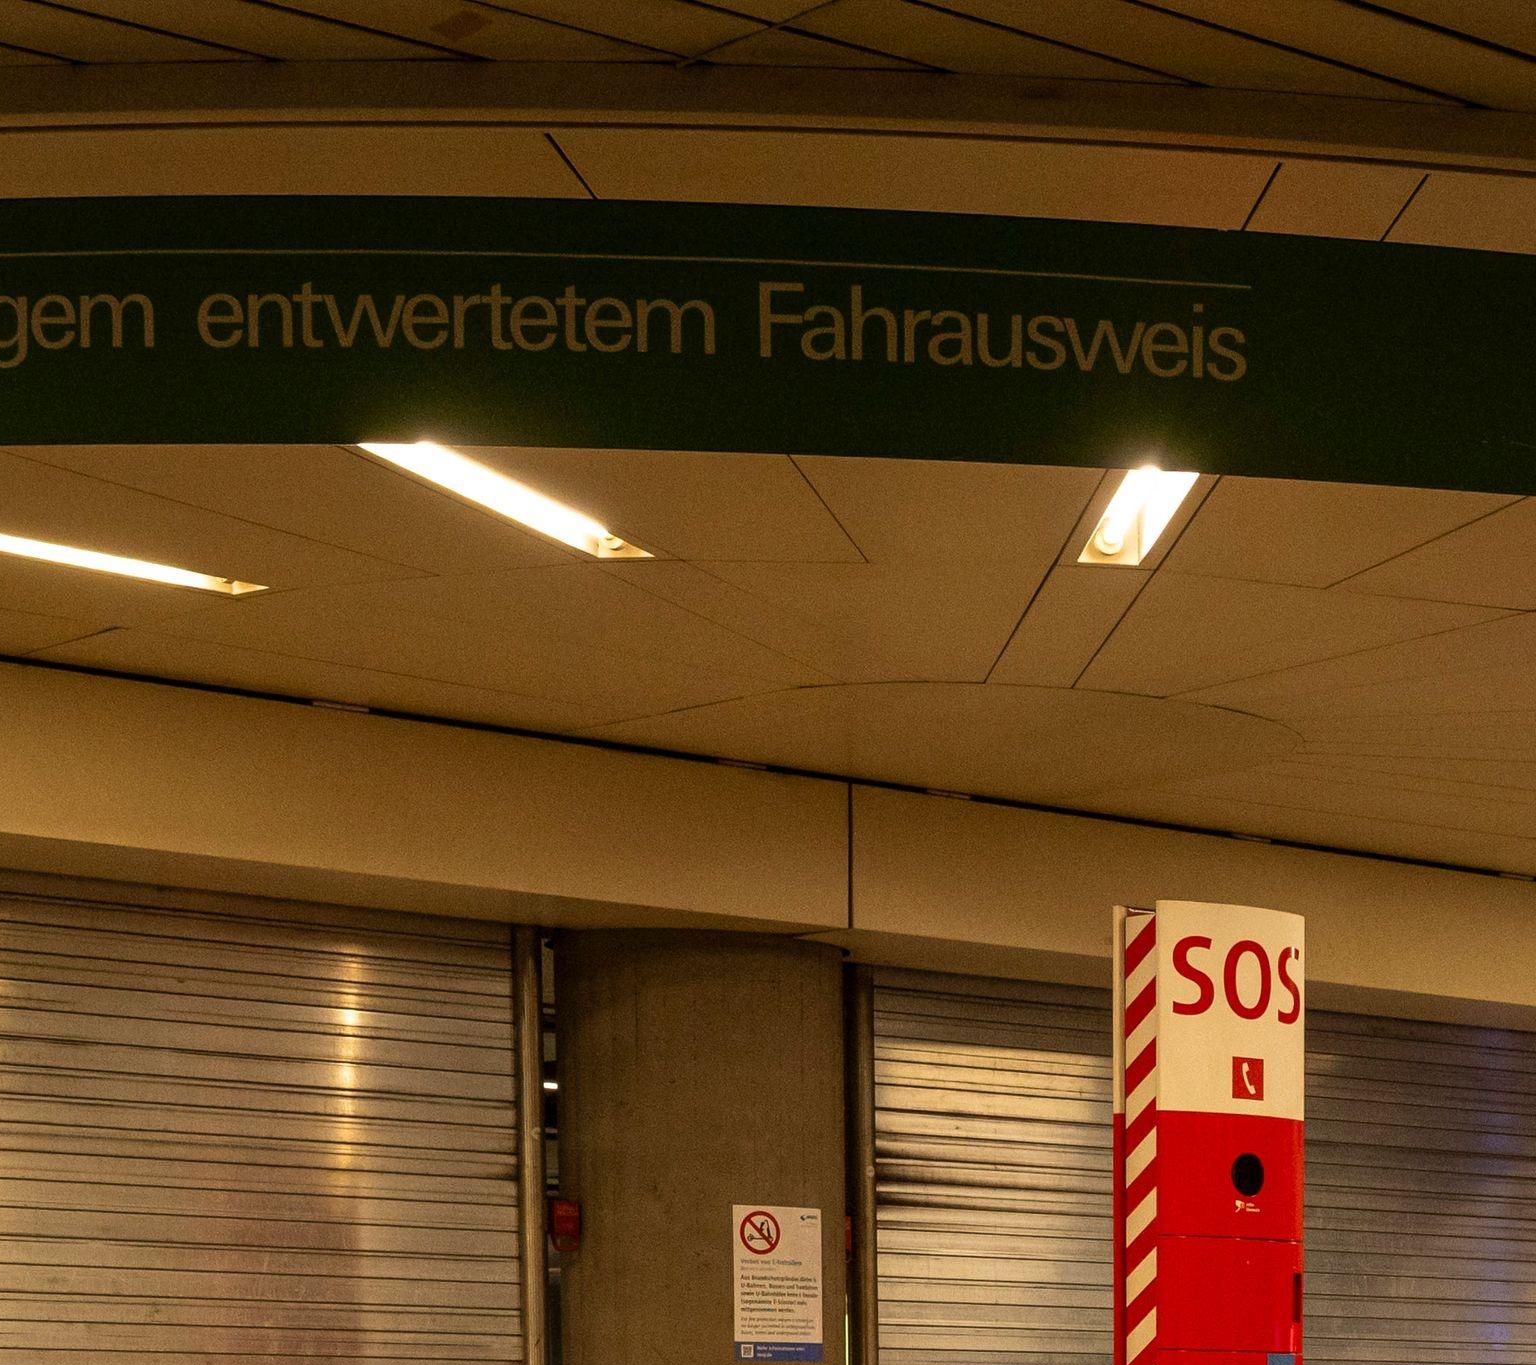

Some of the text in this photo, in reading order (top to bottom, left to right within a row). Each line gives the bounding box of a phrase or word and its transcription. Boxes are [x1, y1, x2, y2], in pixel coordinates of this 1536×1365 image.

[196, 280, 716, 355] entwertetem
[758, 280, 1248, 383] Fahrausweis
[1172, 935, 1300, 1025] SOS
